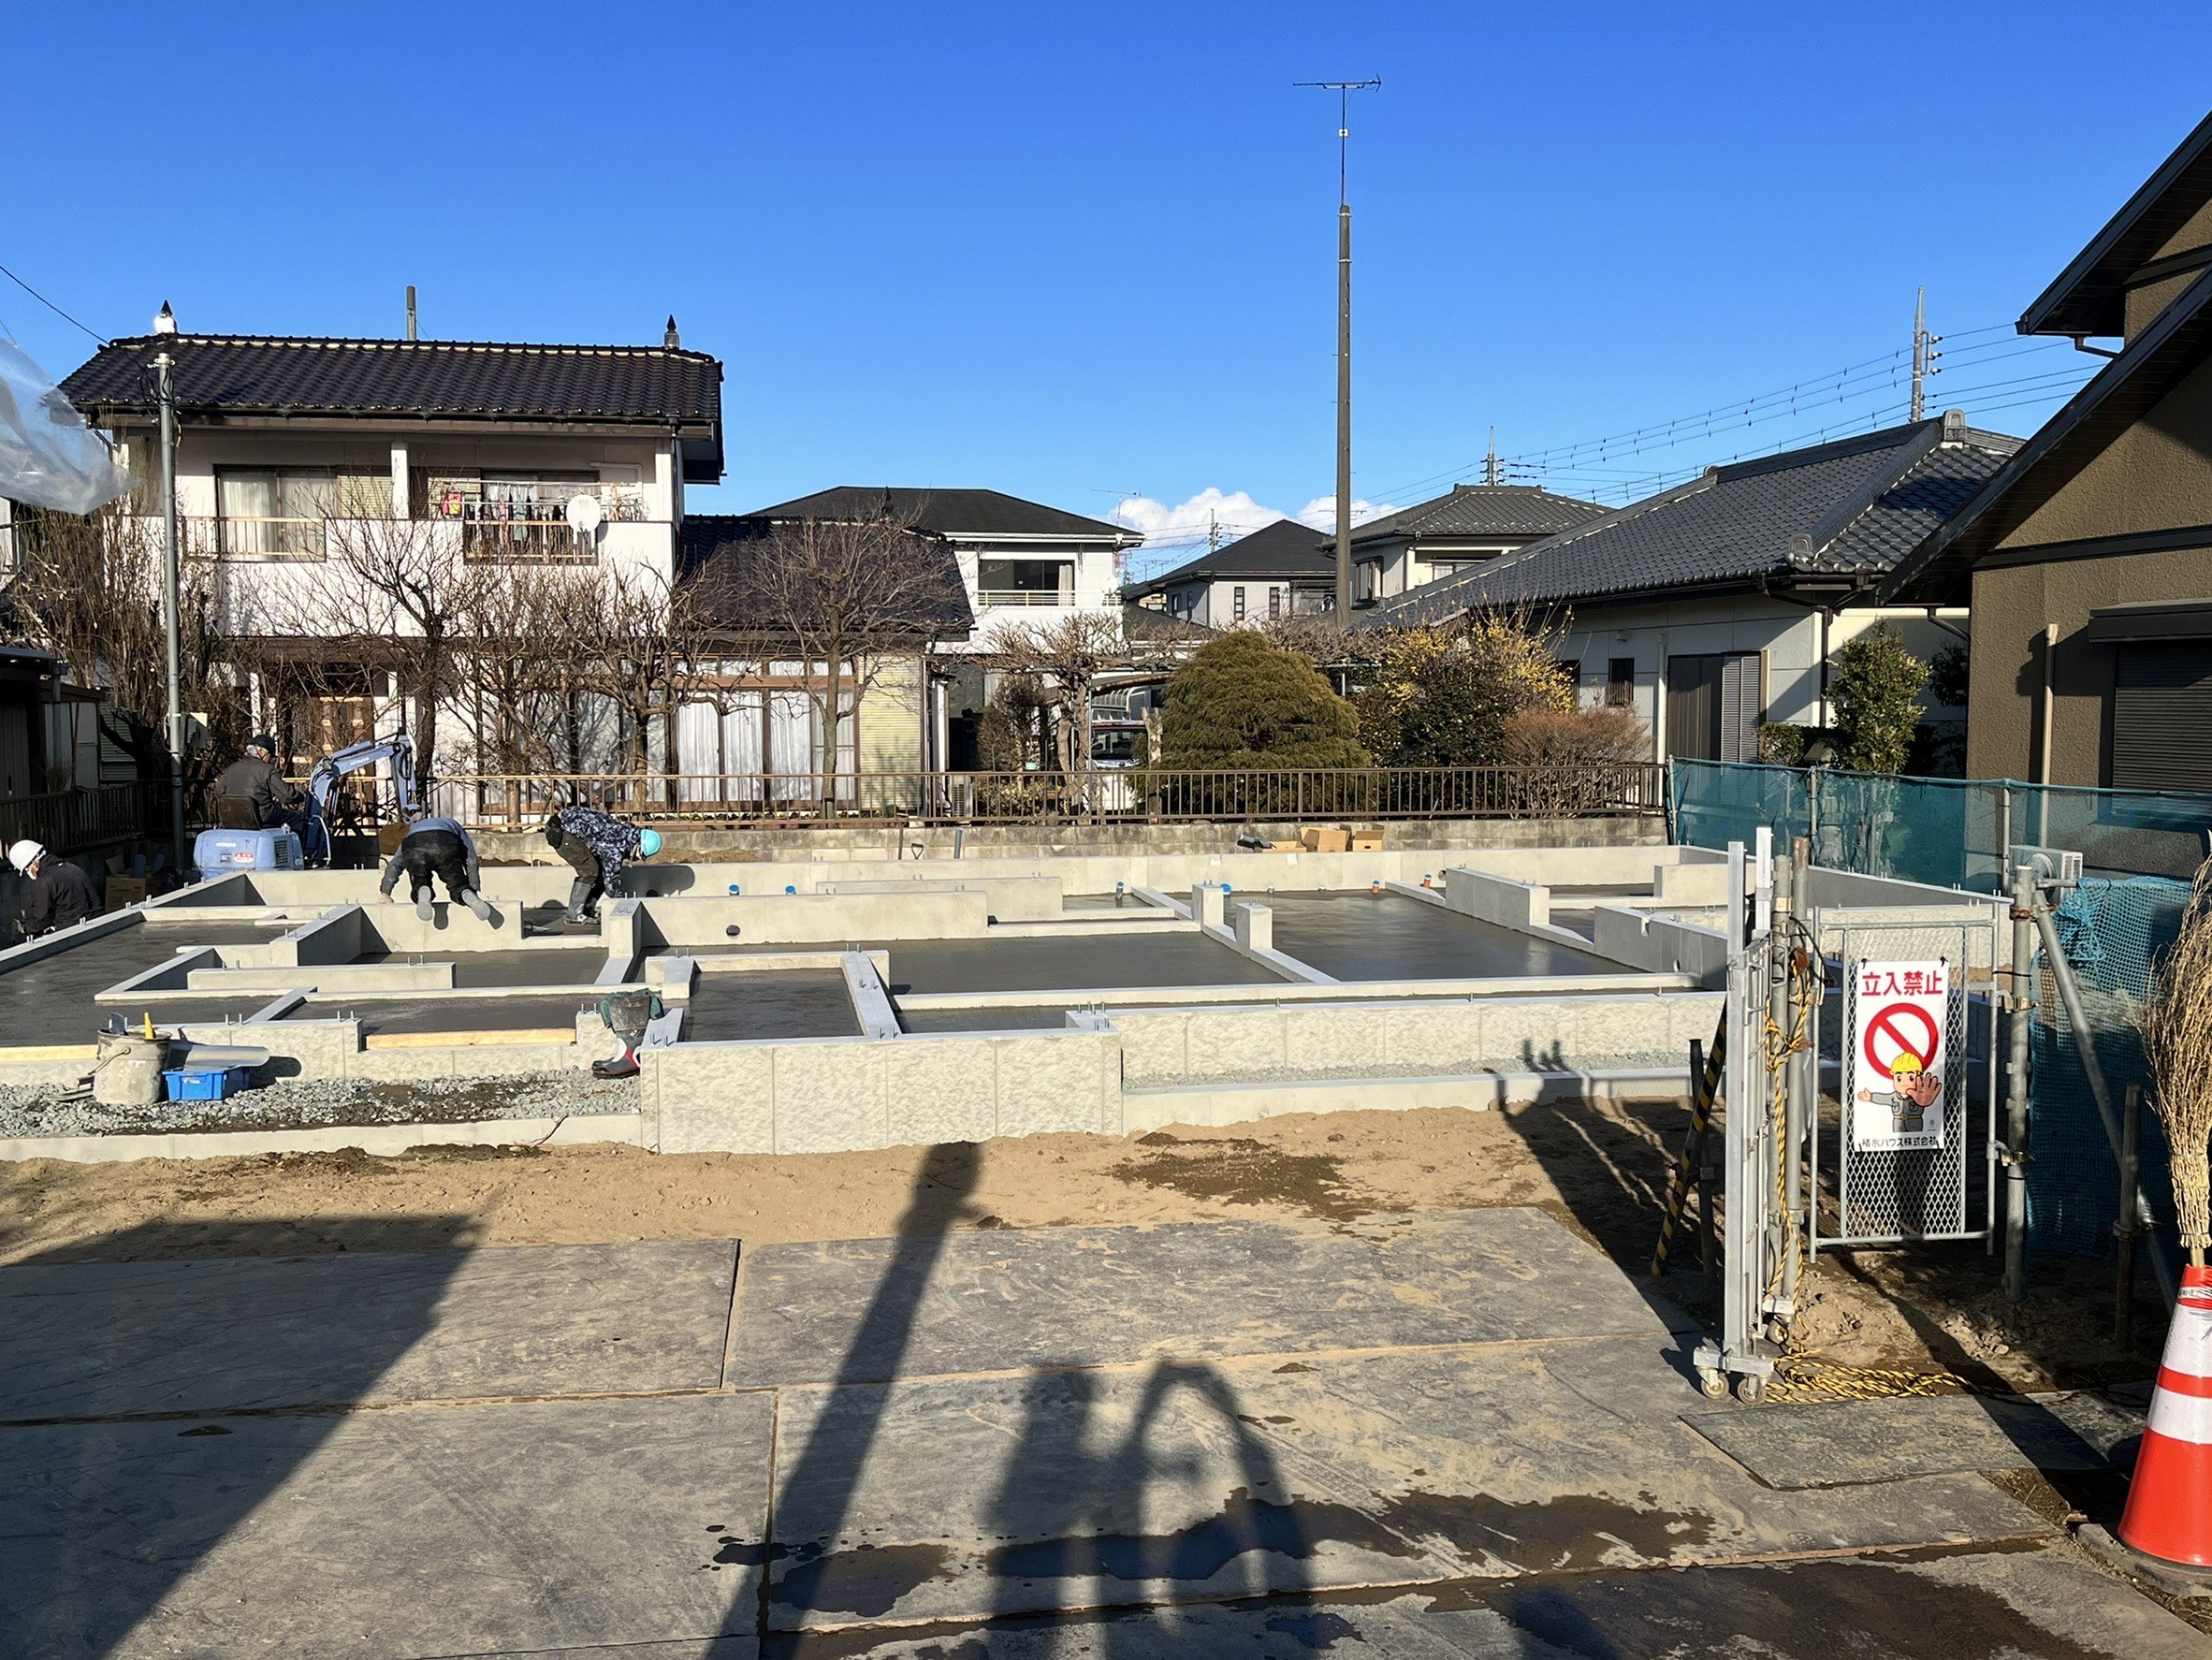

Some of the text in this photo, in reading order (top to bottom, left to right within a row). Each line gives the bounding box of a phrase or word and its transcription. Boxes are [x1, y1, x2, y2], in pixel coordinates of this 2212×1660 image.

[1861, 970, 1943, 997] 立入禁止
[1861, 1136, 1938, 1148] 積水ハウス株式会社
